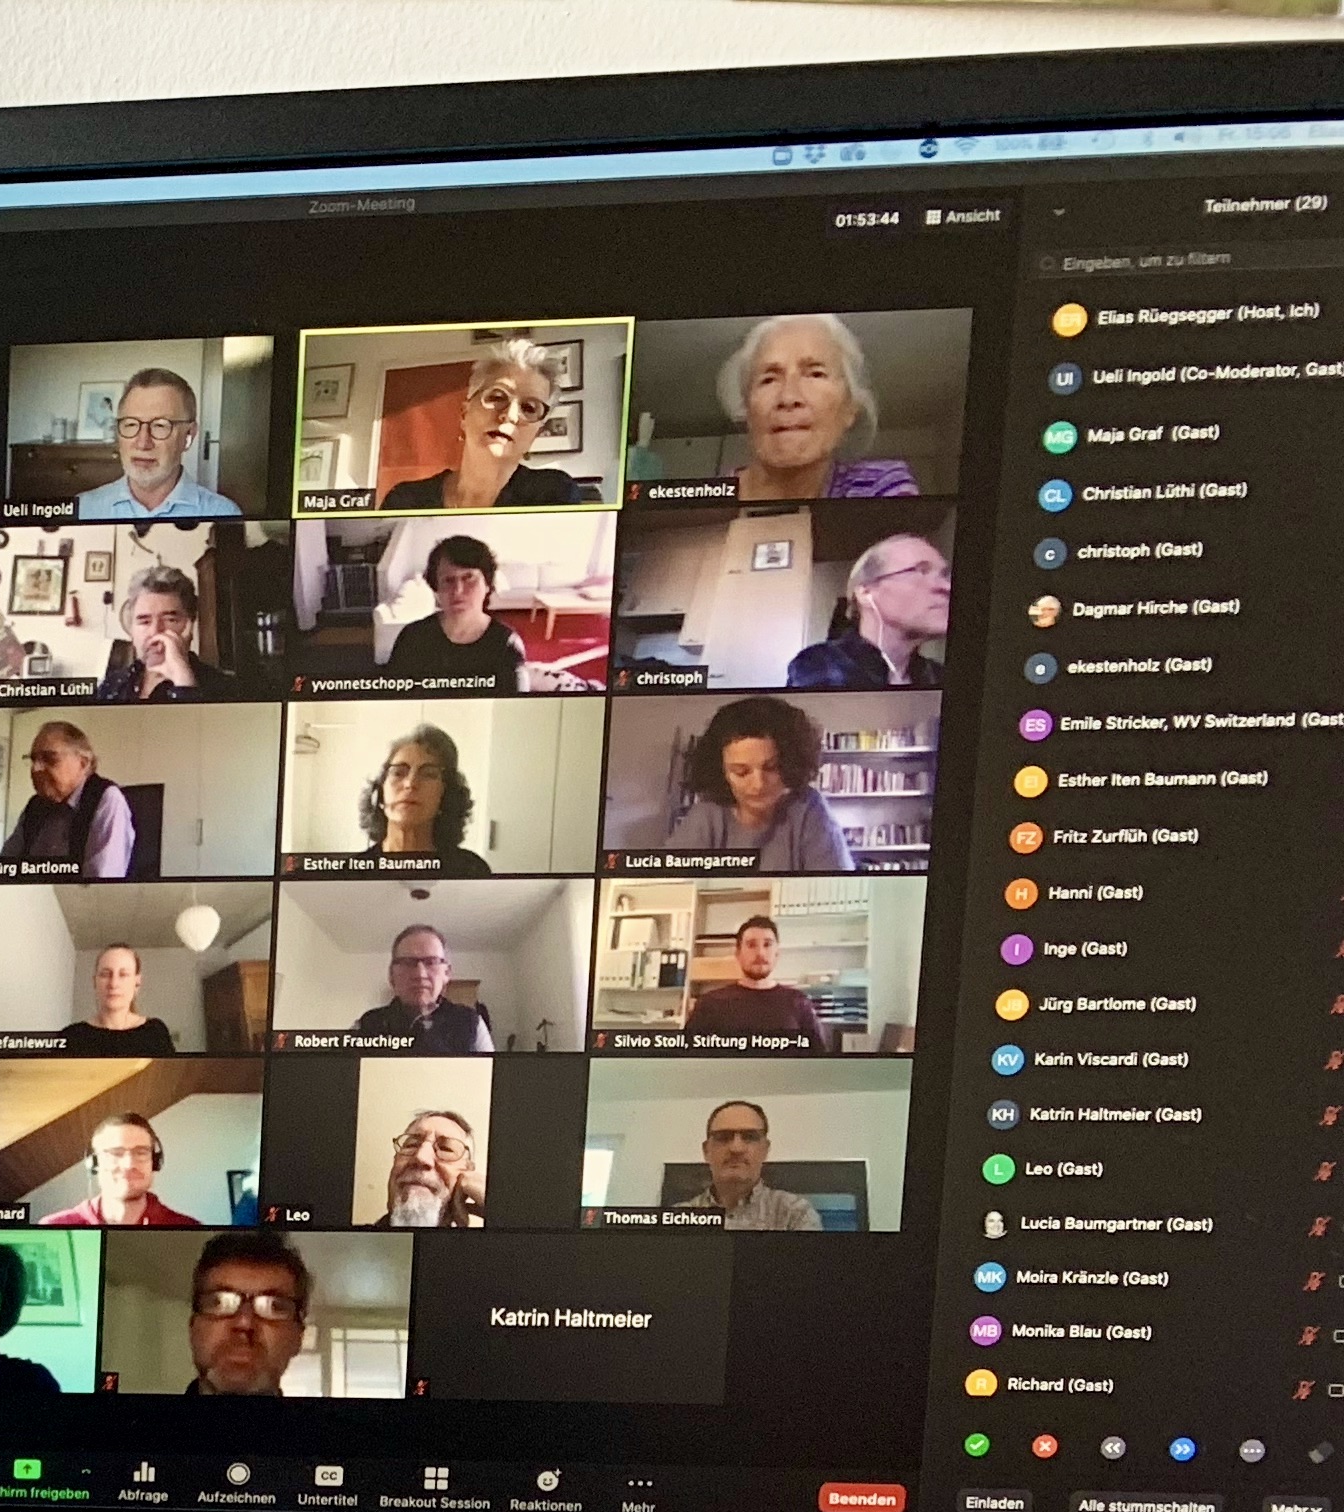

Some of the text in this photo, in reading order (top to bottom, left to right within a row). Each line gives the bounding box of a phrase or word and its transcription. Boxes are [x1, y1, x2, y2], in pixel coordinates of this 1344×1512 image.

[1204, 195, 1328, 214] Teilnehmer (29)
[835, 211, 900, 228] 01:53:44
[945, 208, 1002, 224] Ansicht
[1097, 310, 1135, 326] Elias
[1137, 308, 1234, 326] Rüegsegger
[1236, 304, 1286, 322] (Host,
[648, 482, 736, 499] ekestenholz
[3, 501, 74, 519] Ueli Ingold
[303, 493, 372, 511] Maja Graf
[311, 674, 496, 693] yvonnetschopp-camenzind
[636, 670, 703, 687] christoph
[60, 682, 94, 696] Lüthi
[1060, 712, 1296, 732] Emile Stricker, WV Switzerland
[20, 860, 80, 874] Bartlome
[303, 856, 441, 871] Esther Iten Baumann
[625, 854, 756, 870] Lucia Baumgartner
[294, 1033, 415, 1050] Robert Frauchiger
[614, 1033, 810, 1050] Silvio Stoll, Stiftung Hopp-la
[286, 1209, 311, 1222] Leo
[603, 1211, 722, 1225] Thomas Eichkorn
[490, 1307, 653, 1329] Katrin Haltmeier
[1007, 1376, 1114, 1395] Richard (Gast)
[30, 1486, 90, 1502] freigeben
[117, 1488, 169, 1504] Abfrage
[197, 1490, 277, 1504] Aufzeichnen
[297, 1493, 358, 1507] Untertitel
[828, 1492, 897, 1506] Beenden
[379, 1495, 491, 1510] Breakout Session
[510, 1498, 583, 1512] Reaktionen
[965, 1496, 1025, 1510] Einladen
[1078, 1499, 1106, 1512] Alle
